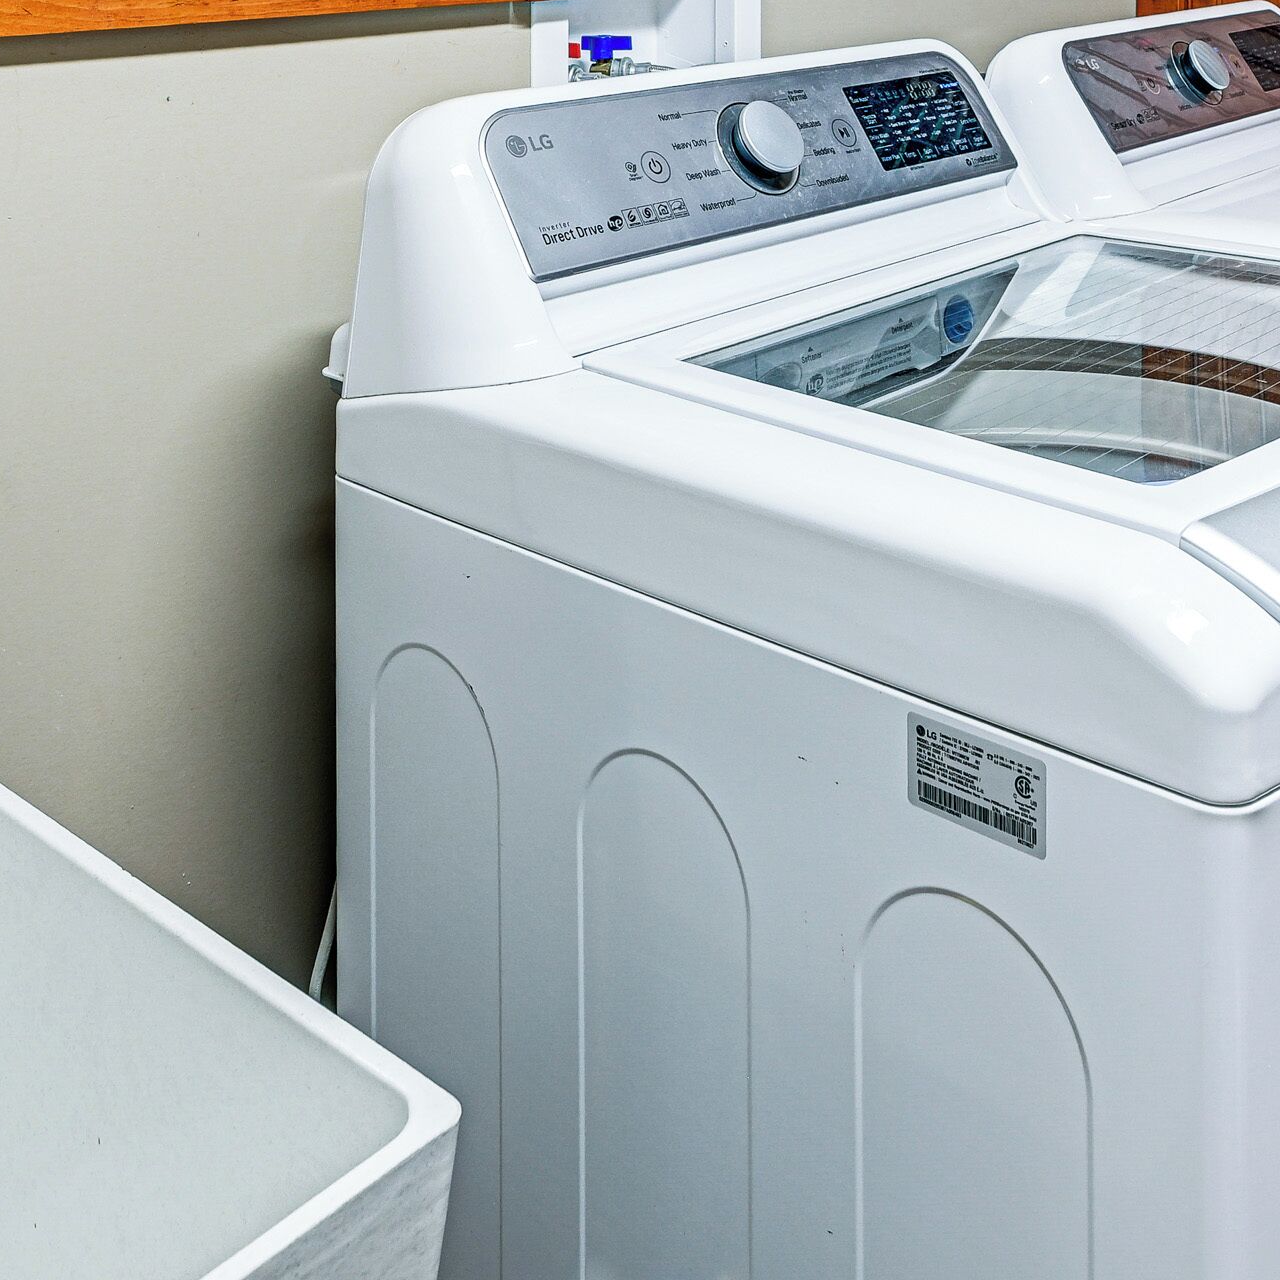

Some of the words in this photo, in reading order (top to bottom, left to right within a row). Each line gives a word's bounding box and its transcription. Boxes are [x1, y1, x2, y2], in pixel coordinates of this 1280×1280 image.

[1086, 59, 1099, 70] LG
[658, 112, 682, 122] Normal
[797, 121, 821, 130] Delicates
[528, 133, 554, 152] LG
[672, 140, 691, 151] Heavy
[692, 138, 707, 149] Duty
[813, 147, 836, 156] Bedding
[685, 171, 703, 182] Deep
[703, 168, 721, 178] Wash
[816, 174, 849, 187] Downloaded
[700, 198, 736, 212] Waterproof
[539, 221, 570, 233] Inverter
[542, 229, 576, 246] Direct
[577, 224, 605, 239] Drive
[891, 321, 913, 334] Detergent
[801, 351, 822, 364] Softener
[927, 729, 937, 741] LG
